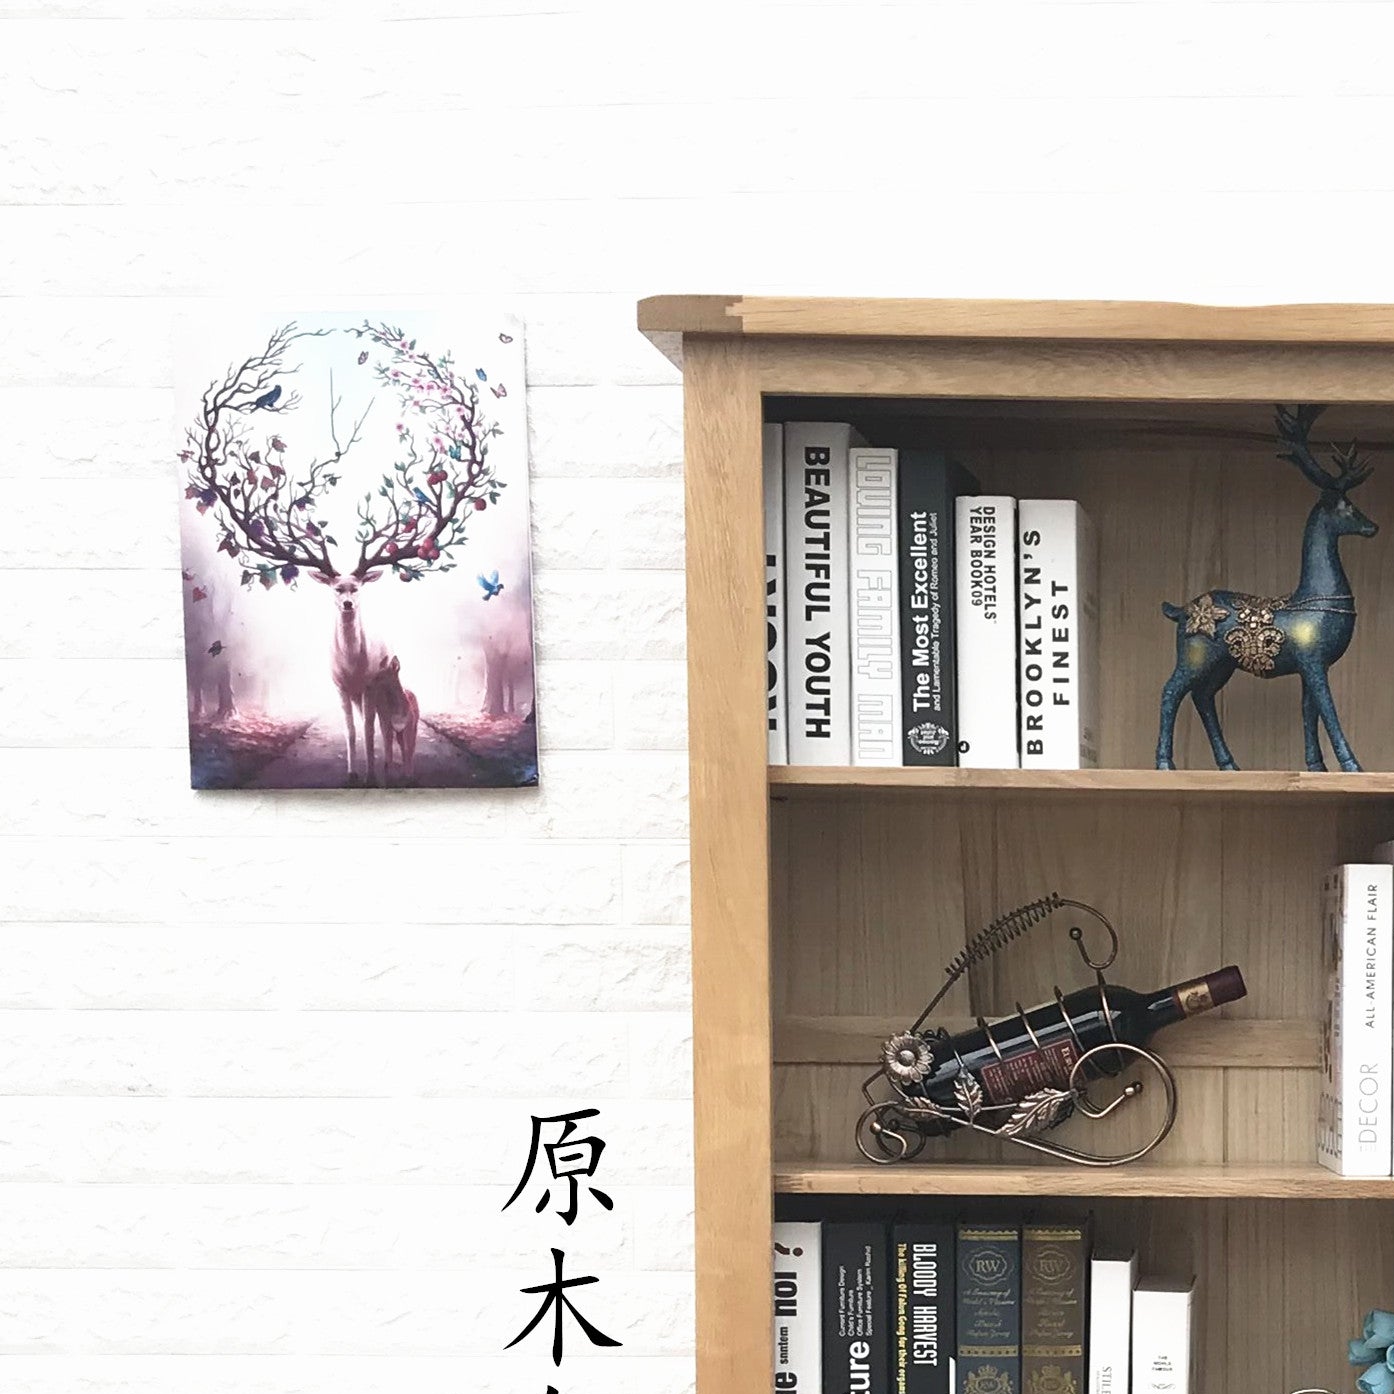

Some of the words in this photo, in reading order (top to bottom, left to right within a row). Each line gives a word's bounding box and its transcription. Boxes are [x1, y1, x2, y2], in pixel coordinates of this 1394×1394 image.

[803, 445, 831, 623] BEAUTIFUL
[856, 455, 892, 556] LOVING
[969, 505, 983, 545] YEAR
[983, 505, 997, 559] DESIGN
[910, 511, 929, 610] Excellent
[929, 558, 940, 590] Romeo
[856, 569, 893, 680] FAMILY
[911, 615, 930, 668] Most
[1023, 530, 1044, 755] BROOKLYN'S
[1052, 581, 1070, 706] FINEST
[804, 631, 831, 739] YOUTH
[912, 671, 931, 713] The
[858, 693, 894, 760] MAN
[1367, 883, 1379, 921] FLAIR
[912, 1243, 938, 1298] BLOODY
[976, 1259, 1001, 1273] RW
[912, 1305, 938, 1367] HARVEST
